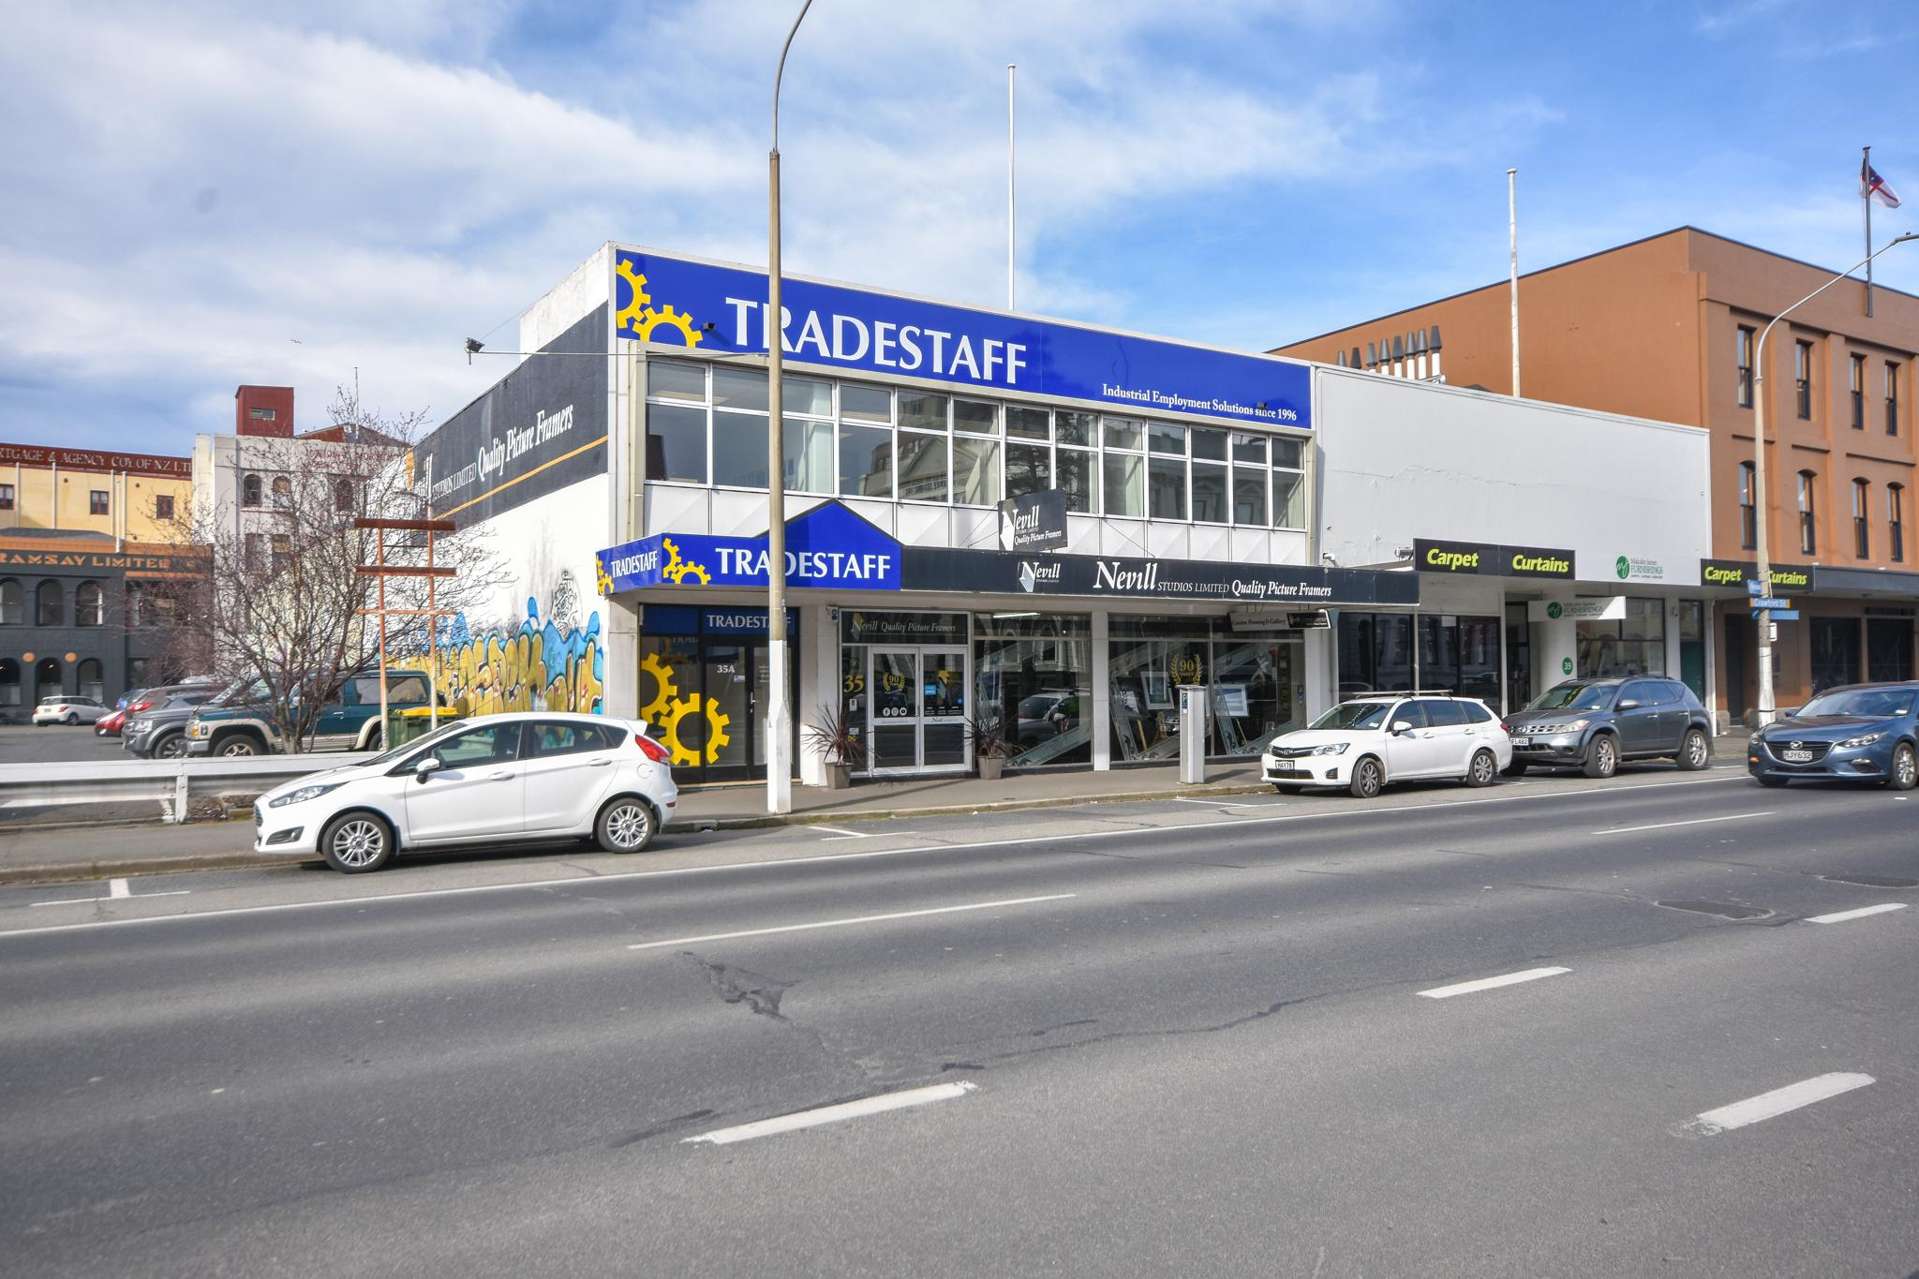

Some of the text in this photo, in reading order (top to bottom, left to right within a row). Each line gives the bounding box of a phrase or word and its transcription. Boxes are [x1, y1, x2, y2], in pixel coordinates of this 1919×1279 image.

[726, 297, 1026, 384] TRADESTAFF
[1103, 383, 1297, 421] Industrial Employment Solutions since 1996
[453, 462, 477, 490] LIMITED
[478, 437, 505, 482] Quality
[505, 426, 535, 462] Picture
[535, 404, 574, 446] Framers
[62, 452, 105, 466] AGENCY
[136, 458, 152, 470] OF
[154, 459, 172, 471] NZ
[1000, 505, 1039, 537] Nevill
[611, 550, 658, 578] TRADESTAFF
[1019, 562, 1061, 581] Nevill
[1427, 549, 1569, 573] Carpet Curtains
[1093, 560, 1332, 598] Nevill STUDIOS LIMITED Quality Picture Framers
[1704, 566, 1742, 584] Carpet
[881, 622, 906, 633] Quality
[908, 622, 930, 632] Picture
[717, 665, 735, 673] 35A
[1180, 659, 1194, 671] 90
[844, 675, 864, 693] 35
